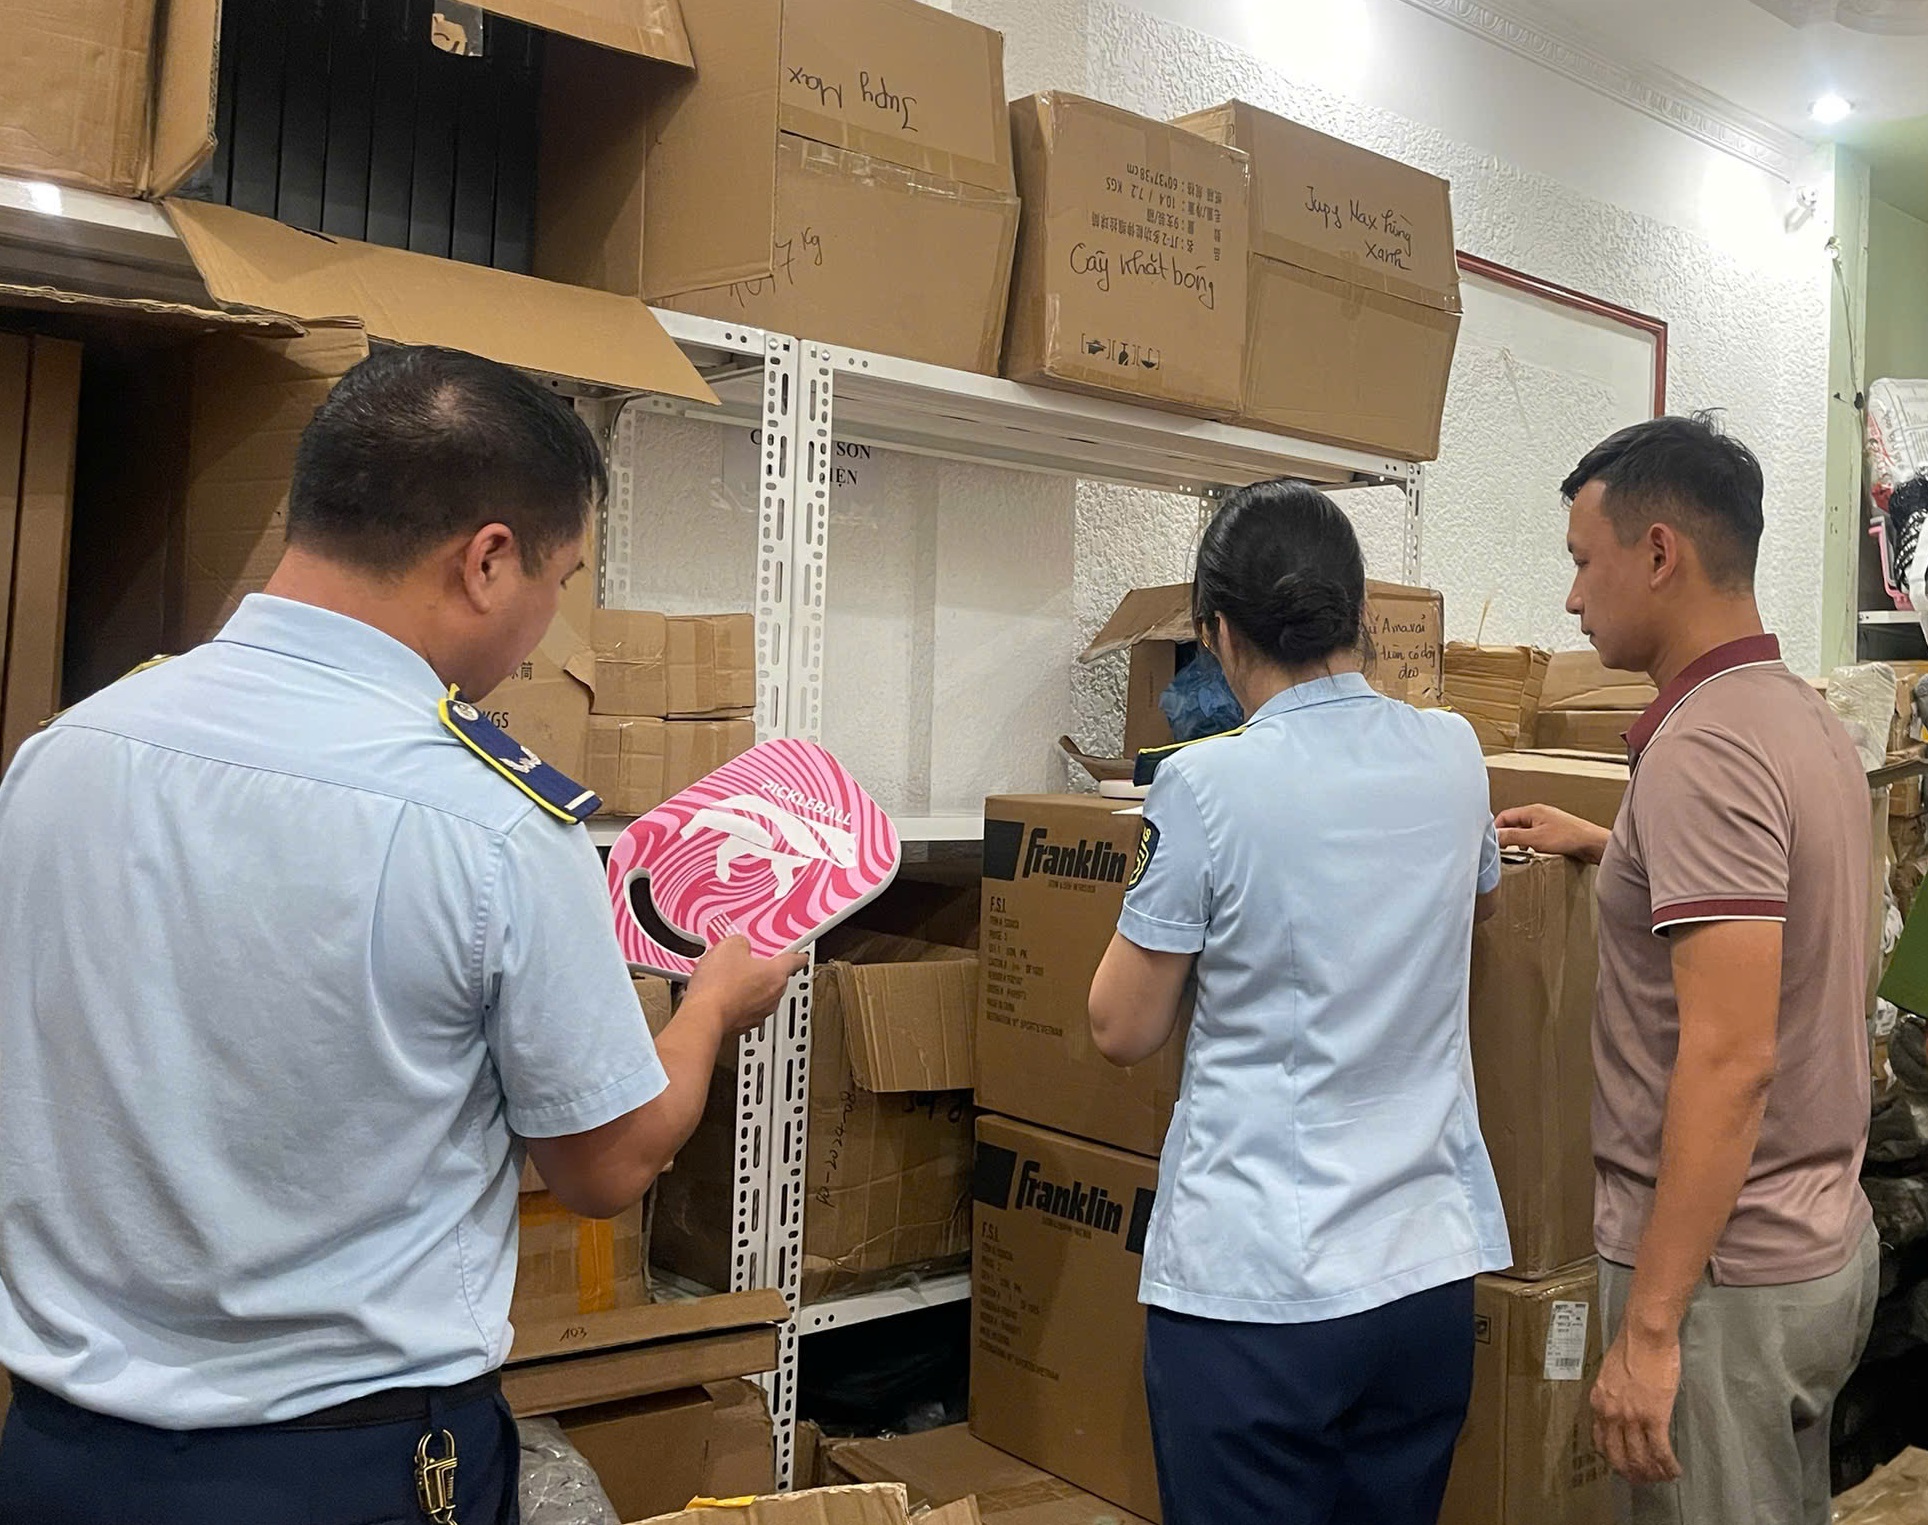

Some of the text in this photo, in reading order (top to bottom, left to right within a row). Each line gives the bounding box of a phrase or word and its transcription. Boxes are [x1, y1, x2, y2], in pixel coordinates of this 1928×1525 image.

[1105, 176, 1123, 194] KGS
[761, 779, 852, 826] PICKLEBALL
[1022, 827, 1127, 883] Franklin
[1015, 1160, 1123, 1235] Franklin
